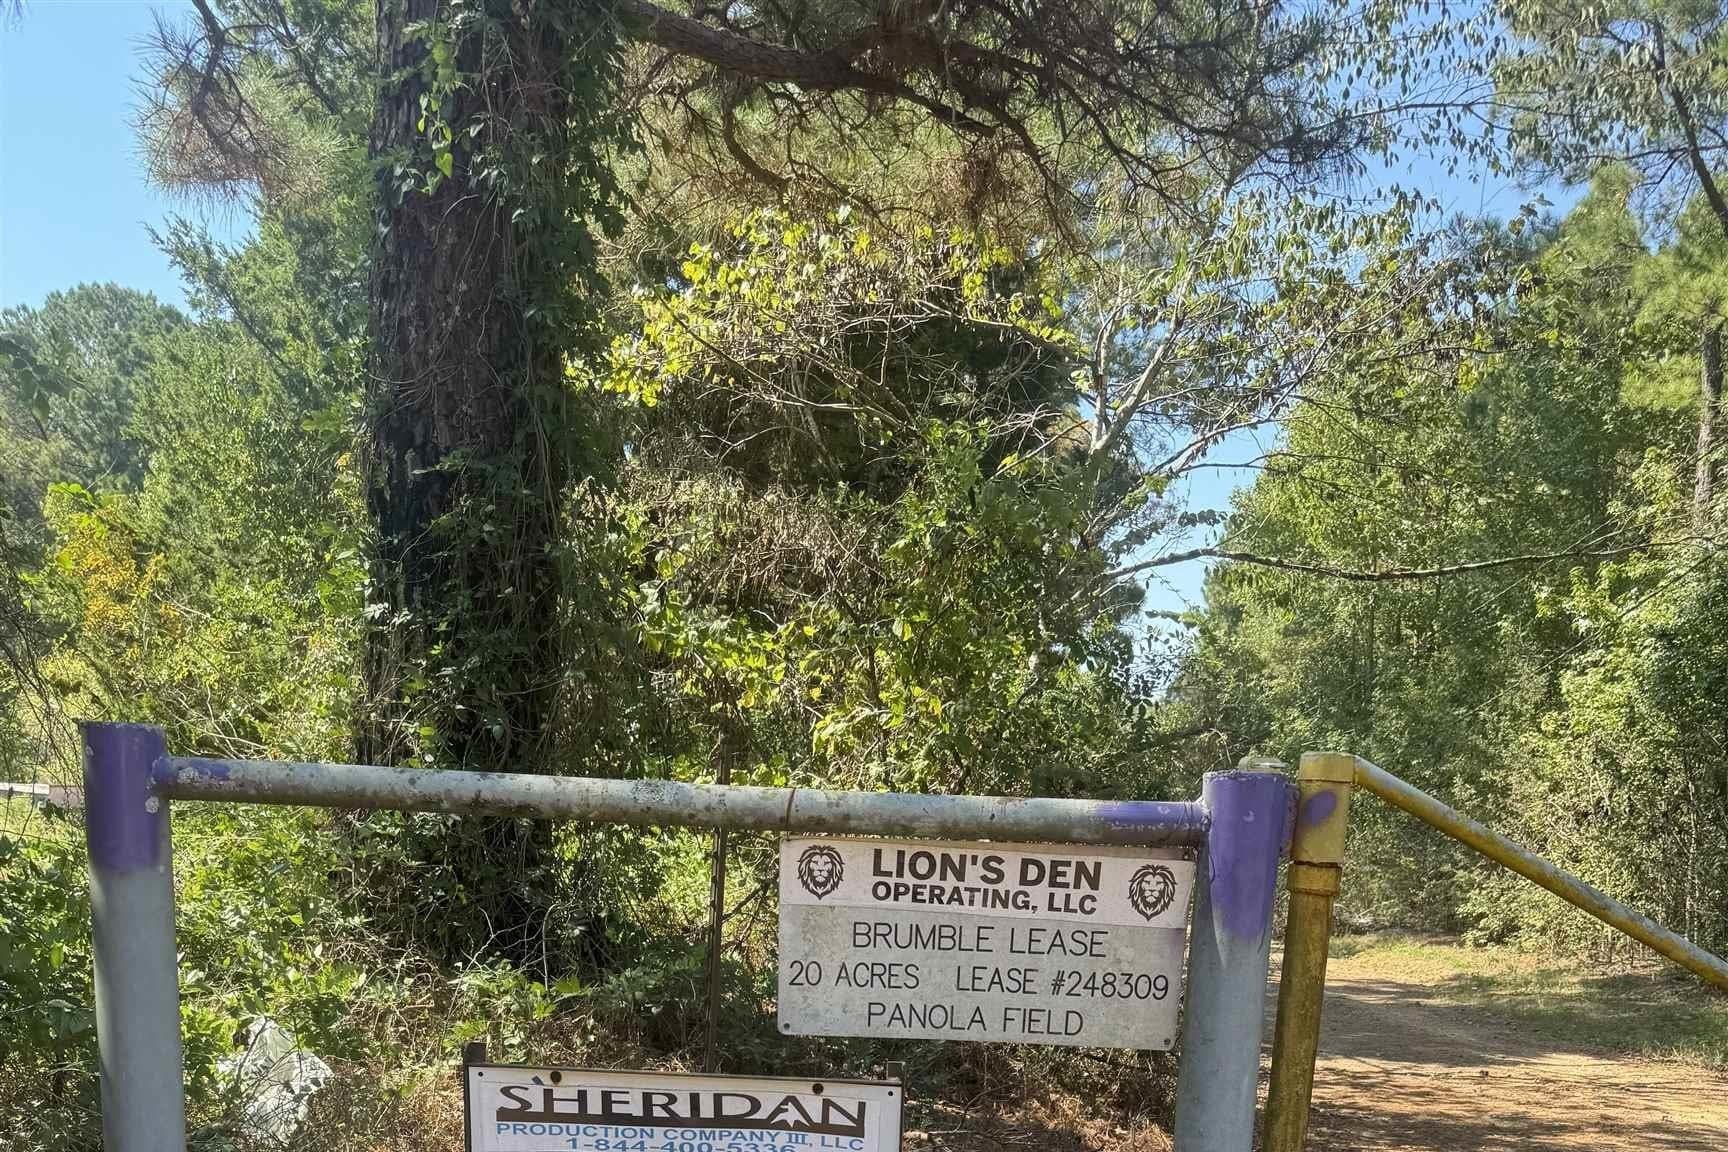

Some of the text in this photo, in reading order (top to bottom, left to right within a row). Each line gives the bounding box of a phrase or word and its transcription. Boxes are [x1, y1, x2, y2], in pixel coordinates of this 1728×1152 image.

[872, 848, 1102, 891] LION'S DEN
[872, 880, 1098, 916] OPERATING, LLC
[853, 921, 1108, 958] BRUMBLE LEASE
[788, 960, 1169, 1001] 20 ACRES LEASE #248309
[867, 1002, 1083, 1036] PANOLA FIELD
[497, 1084, 866, 1131] SHERIDAN
[496, 1122, 655, 1140] PRODUCTION
[663, 1128, 780, 1144] COMPANY
[820, 1135, 865, 1151] LLC
